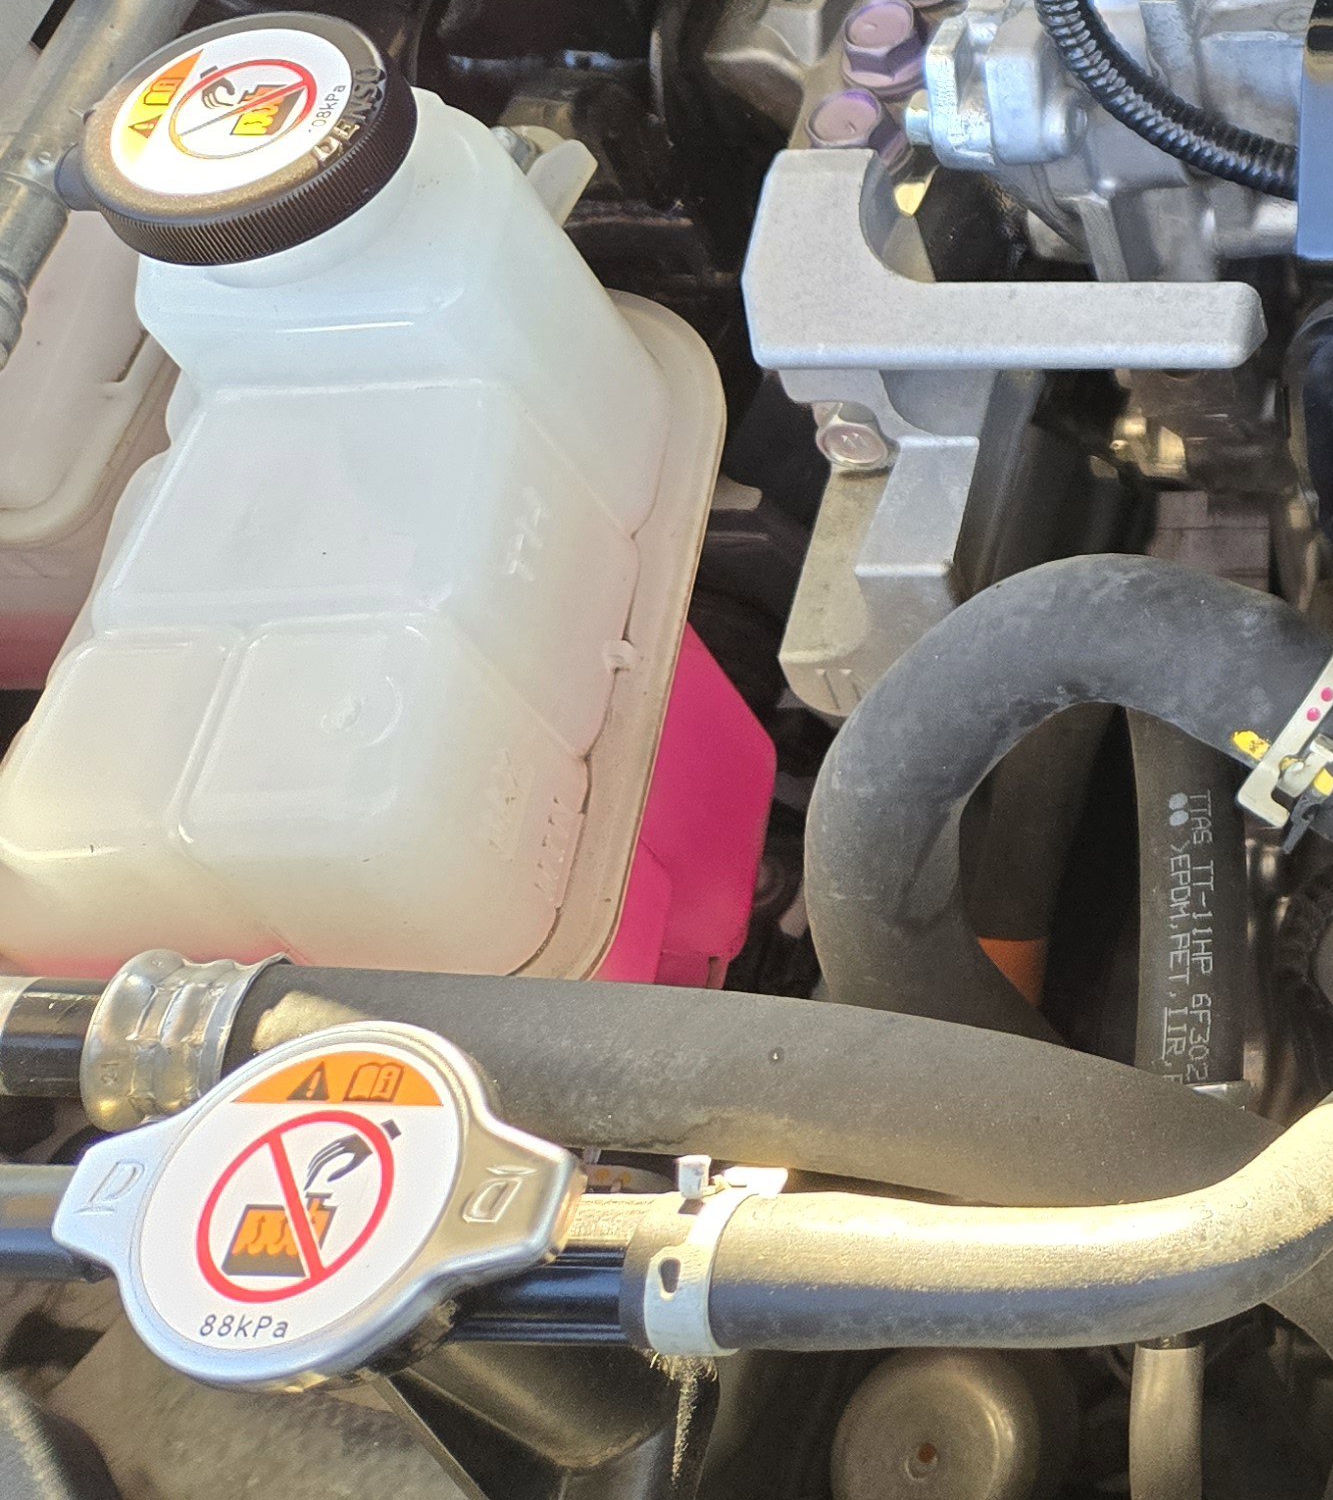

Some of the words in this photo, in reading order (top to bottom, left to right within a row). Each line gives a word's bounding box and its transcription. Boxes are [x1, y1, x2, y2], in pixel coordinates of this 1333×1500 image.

[308, 84, 347, 132] 08kPa
[314, 68, 386, 162] DENSO
[1189, 789, 1213, 846] TTAS
[1191, 859, 1215, 975] TT-11HP
[1187, 993, 1212, 1082] 6F302
[199, 1313, 290, 1339] 88kPa
